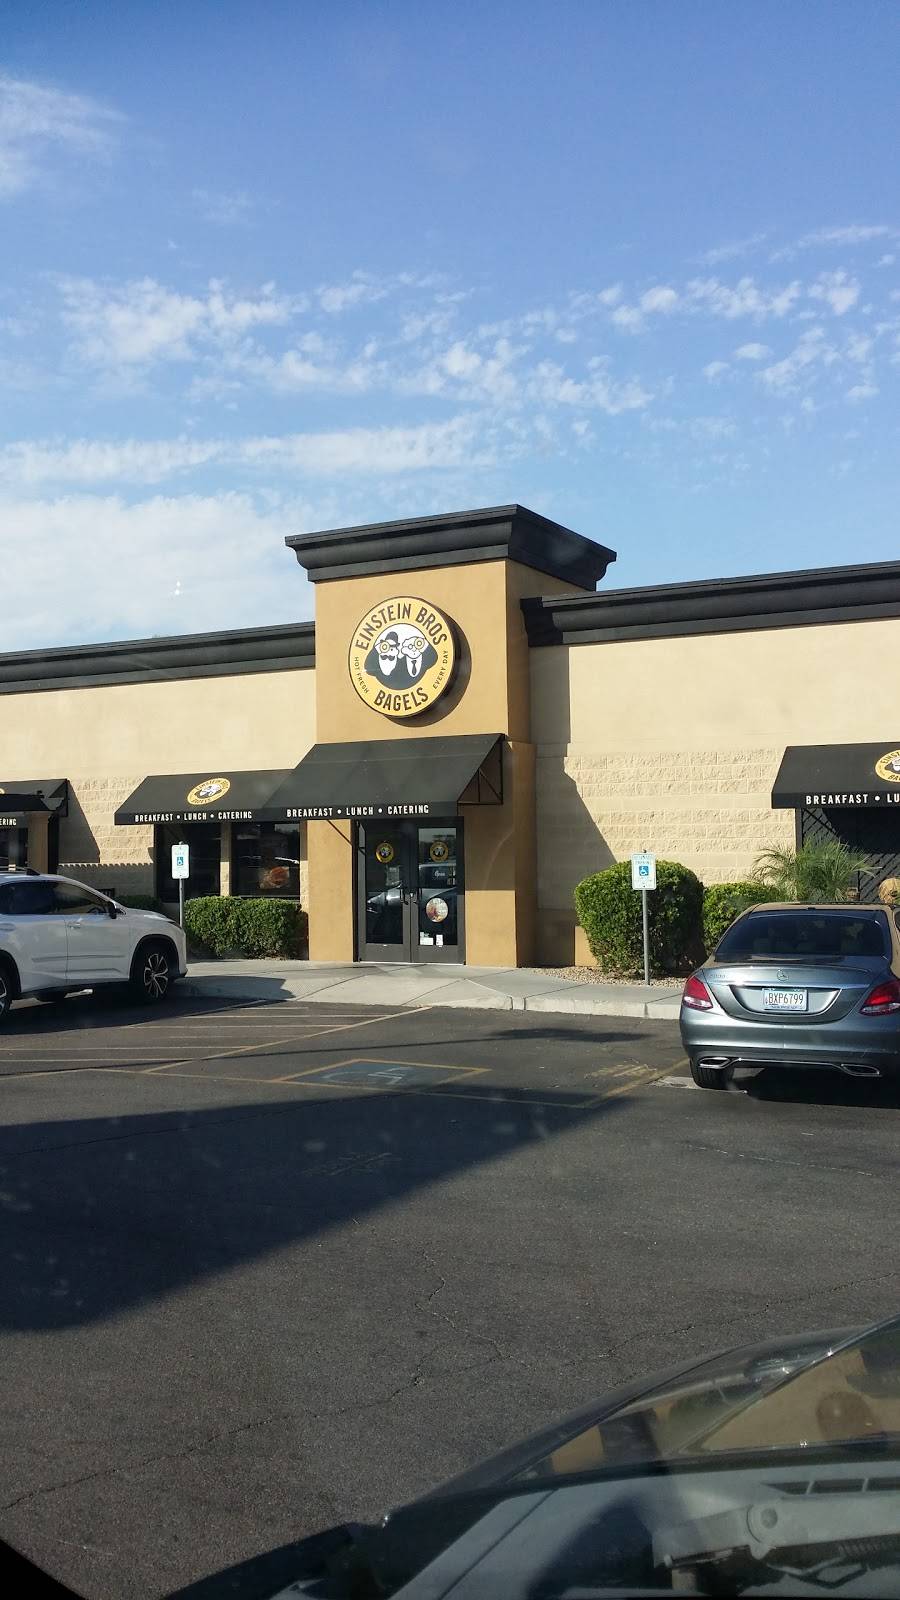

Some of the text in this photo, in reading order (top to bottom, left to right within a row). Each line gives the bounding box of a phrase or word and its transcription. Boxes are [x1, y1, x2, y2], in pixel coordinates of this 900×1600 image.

[355, 603, 448, 651] EINSTEIN BROS
[357, 673, 369, 694] FRESH
[433, 667, 446, 689] EVERY
[373, 687, 429, 711] BAGELS
[805, 793, 900, 805] BREAKFAST LU
[134, 811, 253, 823] BREAKFAST LUNCH CATERING
[286, 804, 430, 818] BREAKFAST LUNCH CATERING
[768, 992, 804, 1005] BXP6799
